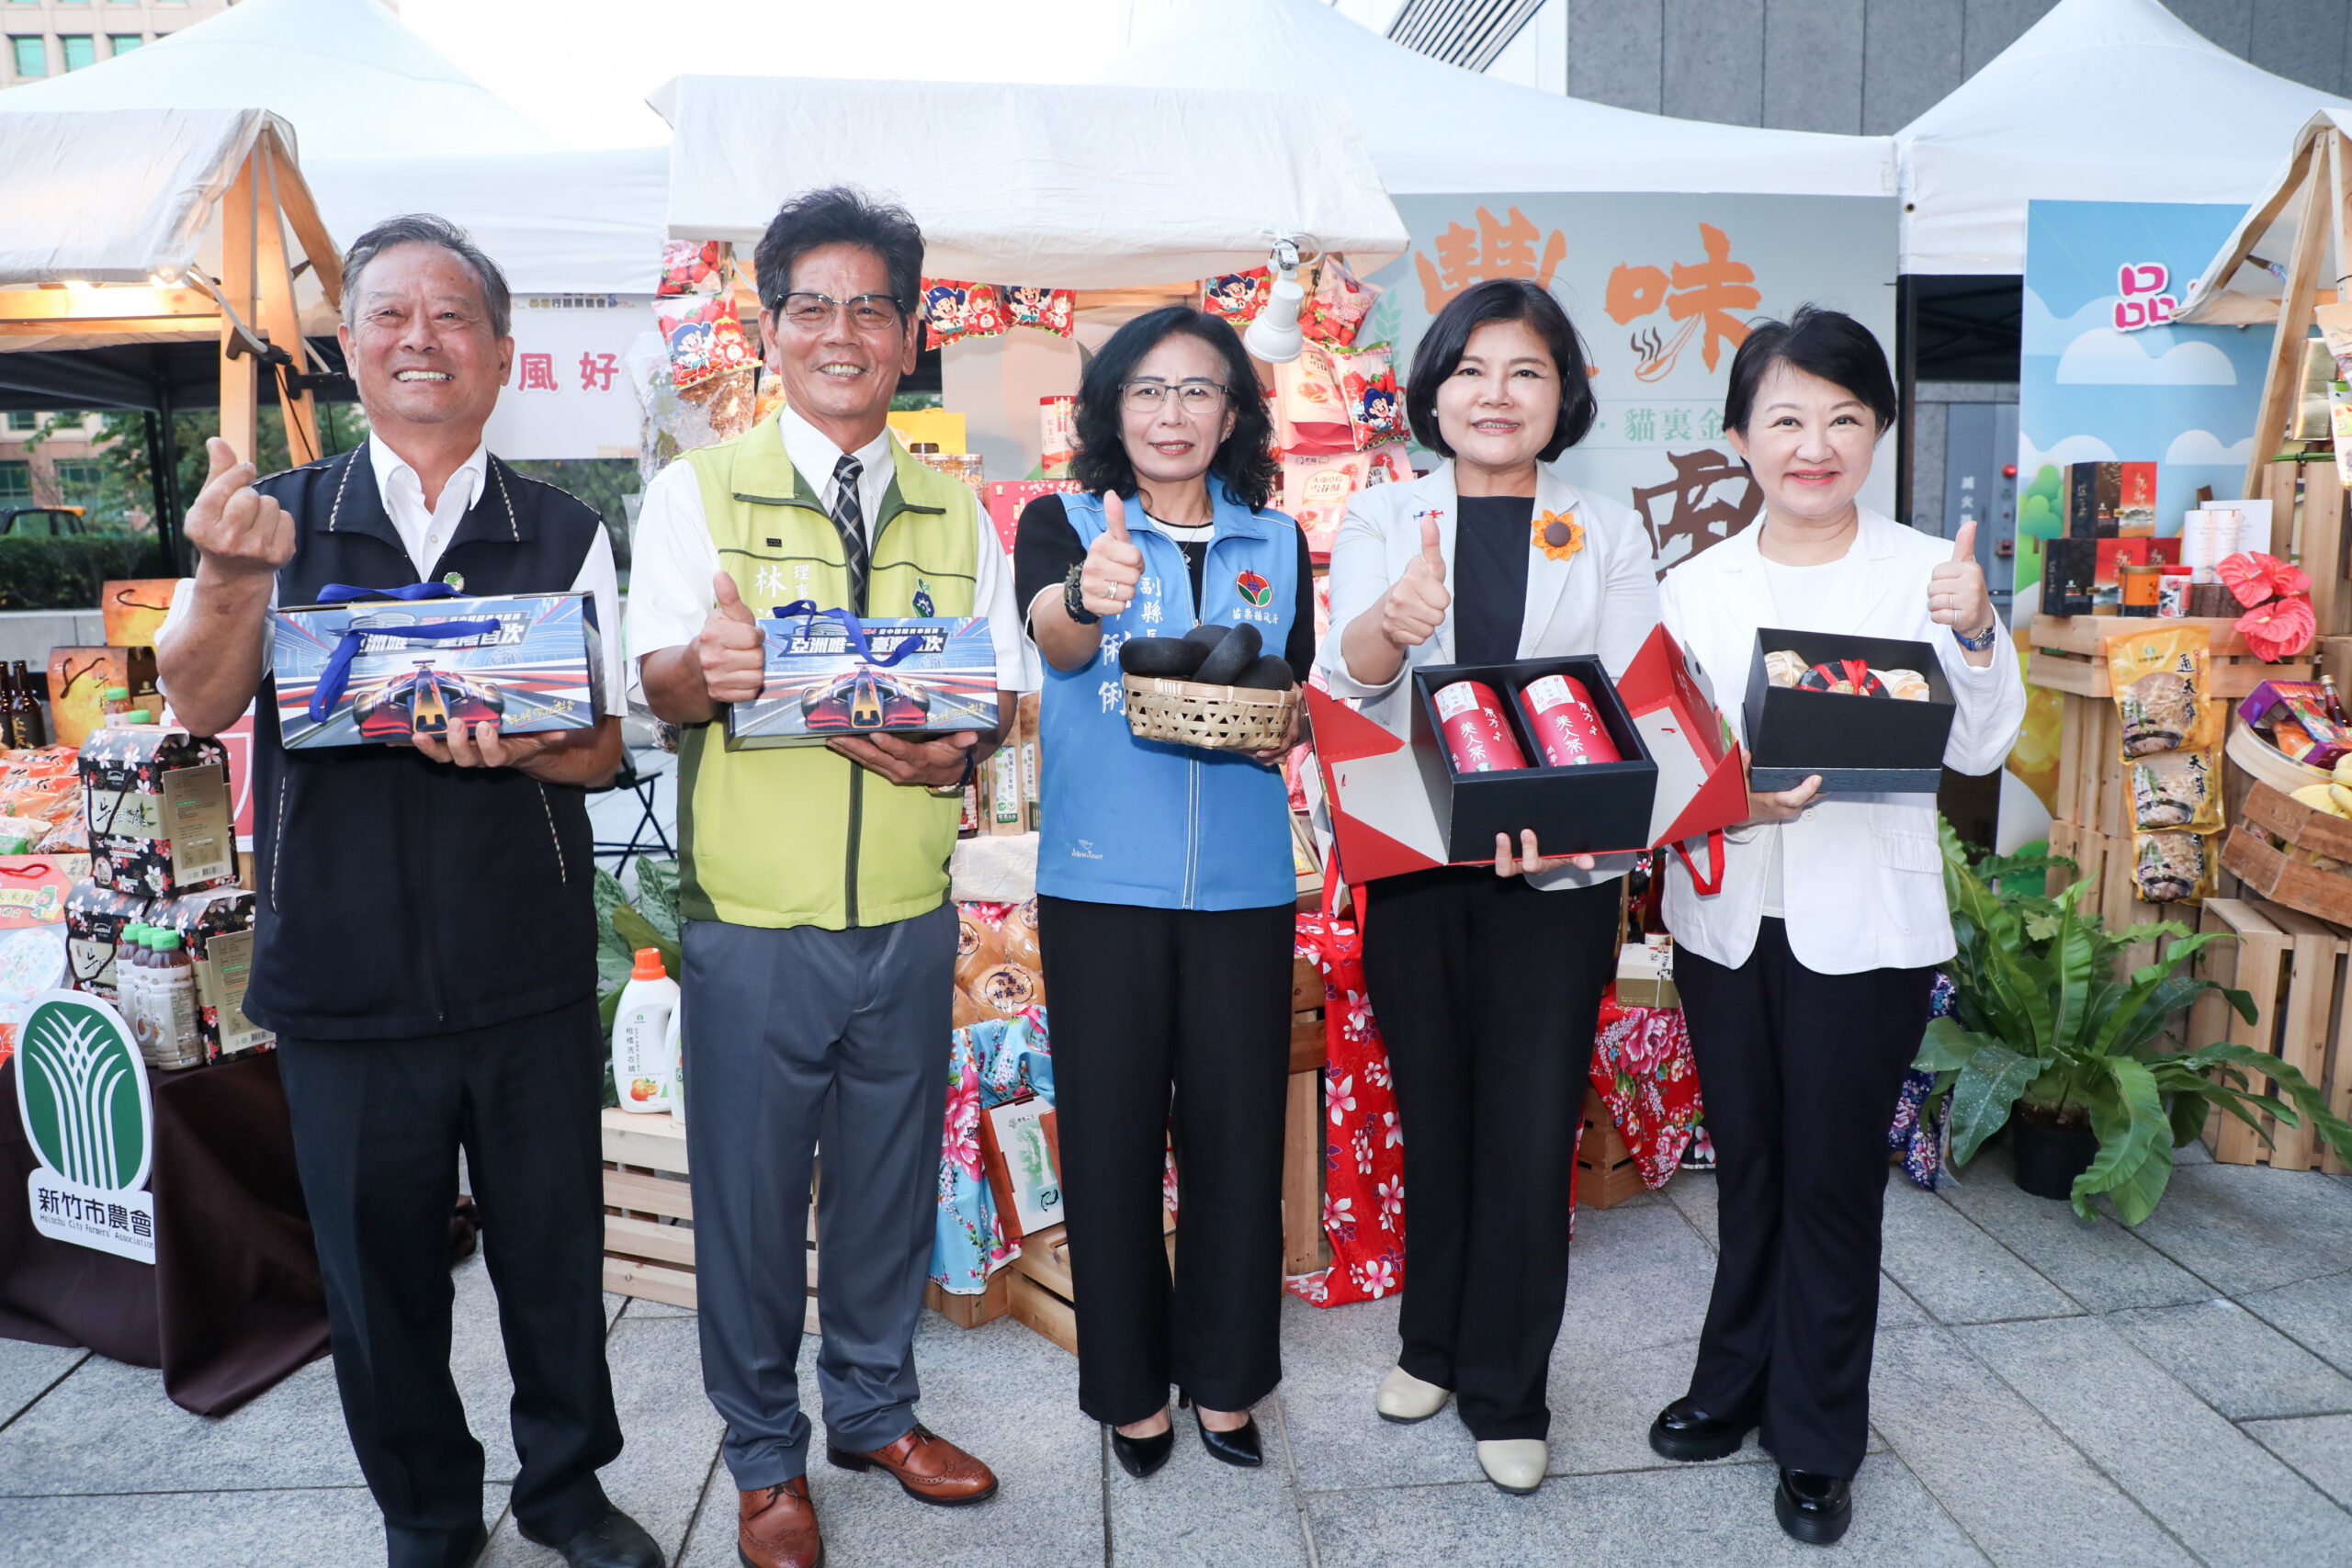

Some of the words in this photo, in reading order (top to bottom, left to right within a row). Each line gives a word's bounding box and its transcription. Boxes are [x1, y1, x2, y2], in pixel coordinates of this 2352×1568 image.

[517, 351, 619, 391] 風好
[1232, 607, 1279, 625] 苗栗縣政府
[869, 636, 944, 653] 臺灣次
[1098, 600, 1132, 716] 俐俐
[1483, 706, 1499, 728] 東方
[1577, 701, 1593, 723] 東方
[1459, 721, 1487, 762] 美人茶
[1555, 714, 1584, 755] 美人茶
[993, 984, 1027, 999] 甘露梨
[38, 1187, 152, 1238] 新竹市農會
[40, 1213, 66, 1227] Hsinchu
[69, 1220, 84, 1232] City
[115, 1232, 155, 1249] Association
